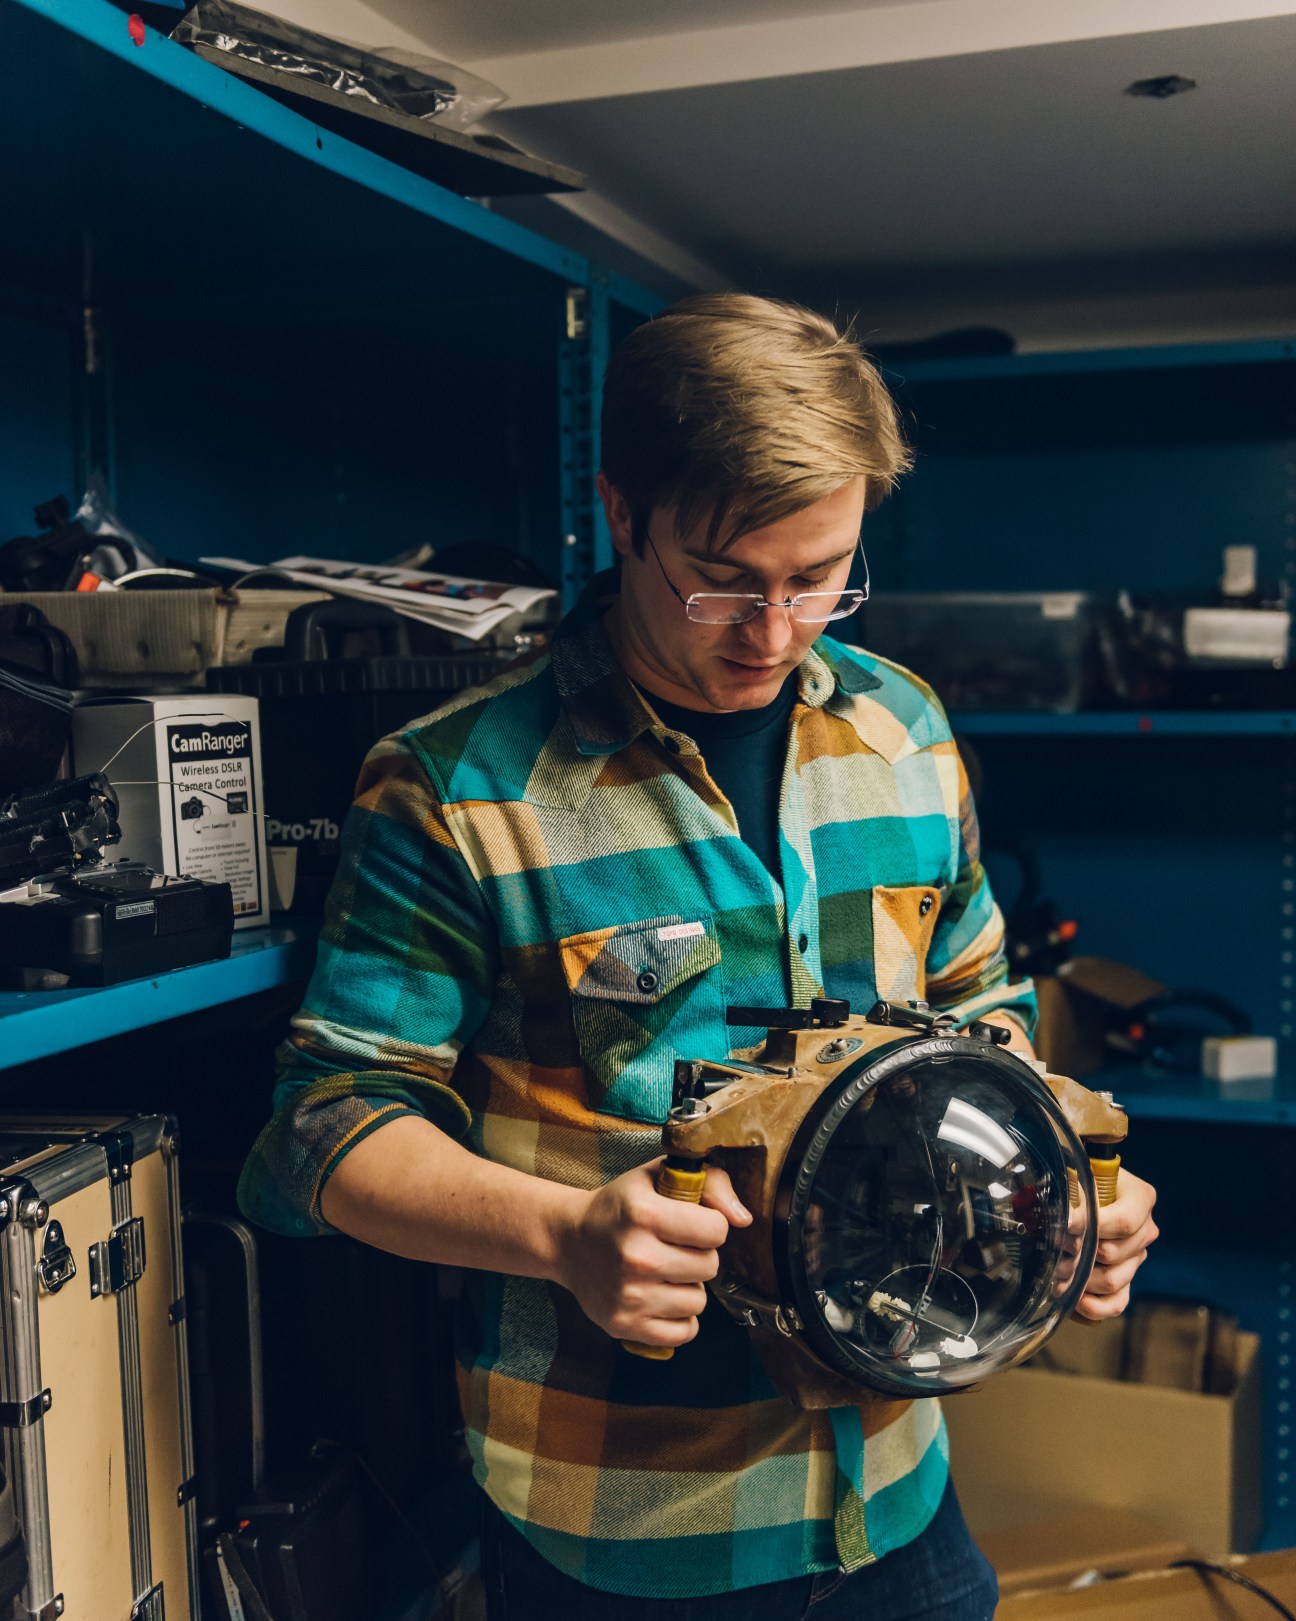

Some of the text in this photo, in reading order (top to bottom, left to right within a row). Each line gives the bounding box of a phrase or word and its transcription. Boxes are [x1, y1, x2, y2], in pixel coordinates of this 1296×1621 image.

[181, 762, 242, 776] Wireless DSLR
[179, 776, 246, 792] Camera Control
[266, 818, 339, 840] Pro-7b
